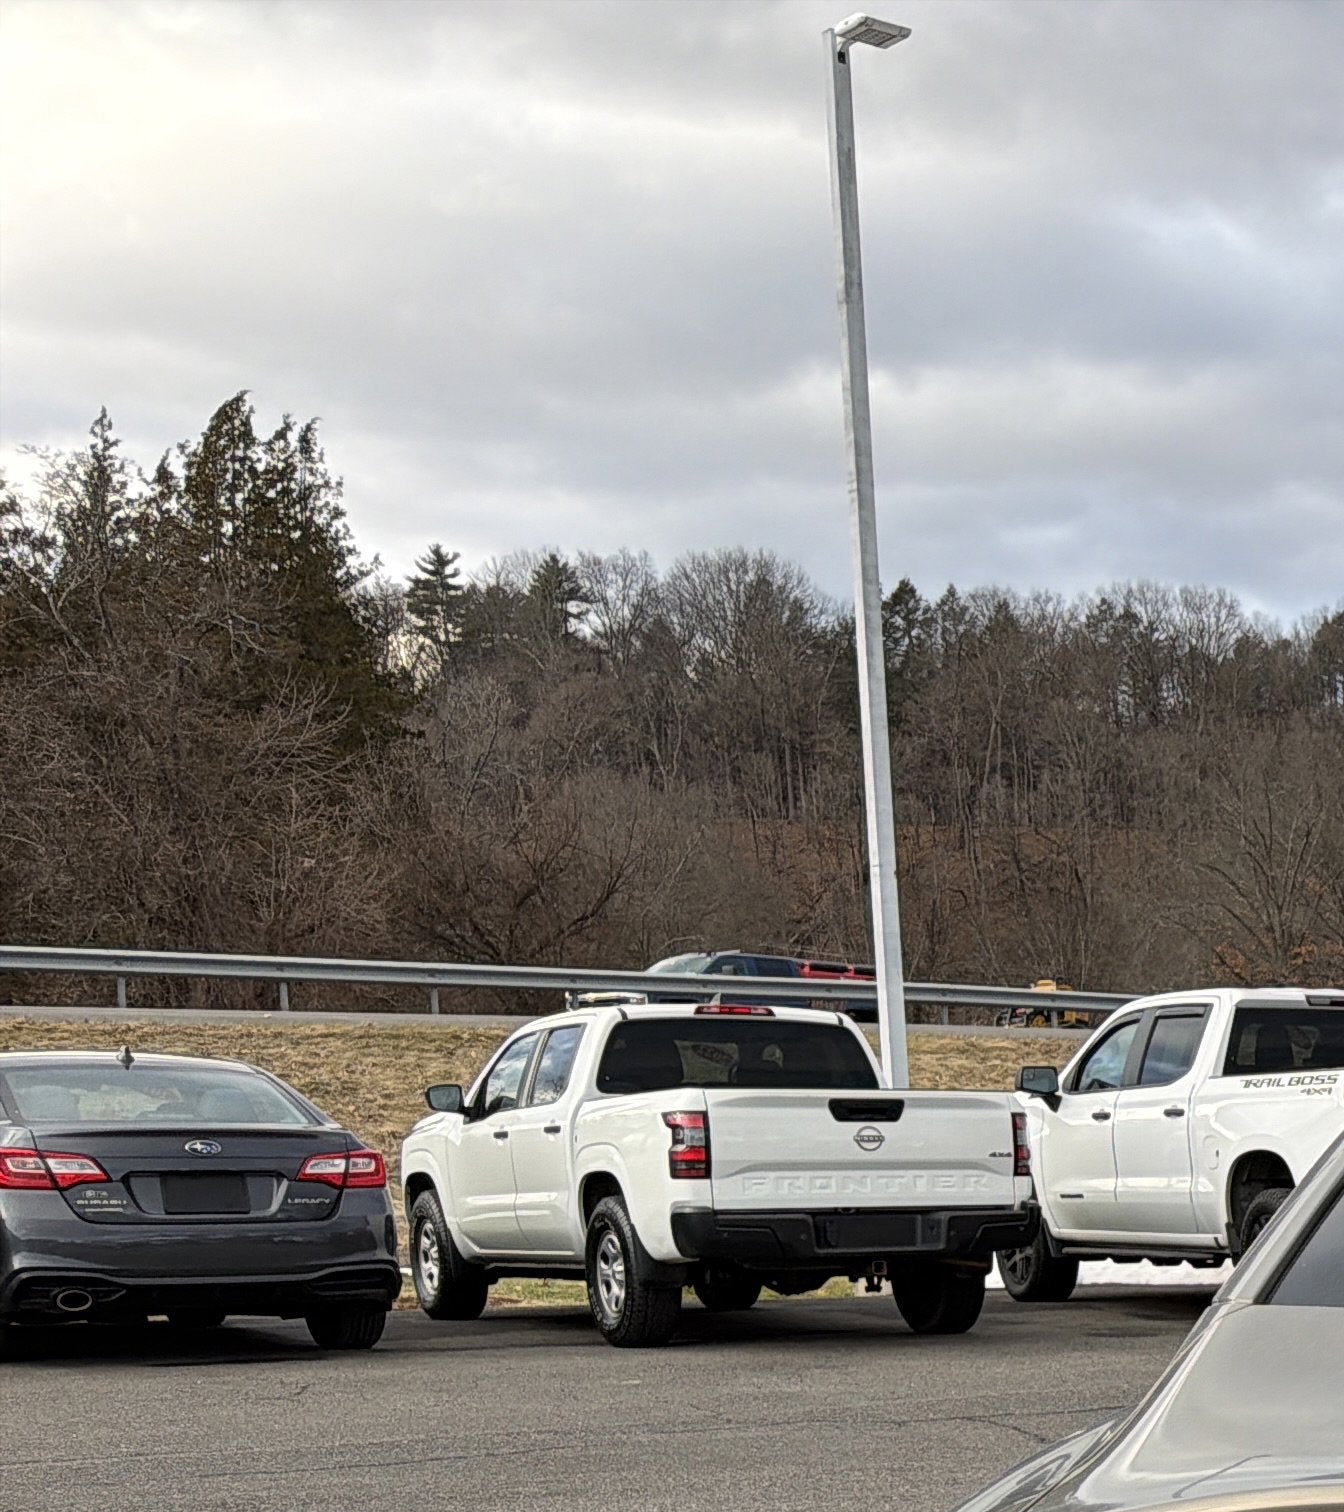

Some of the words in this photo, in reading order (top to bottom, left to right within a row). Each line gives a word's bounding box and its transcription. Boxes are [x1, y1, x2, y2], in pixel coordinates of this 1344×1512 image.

[1241, 1077, 1285, 1088] TRAIL
[1287, 1074, 1339, 1087] BOSS
[742, 1175, 990, 1195] FRONTIER
